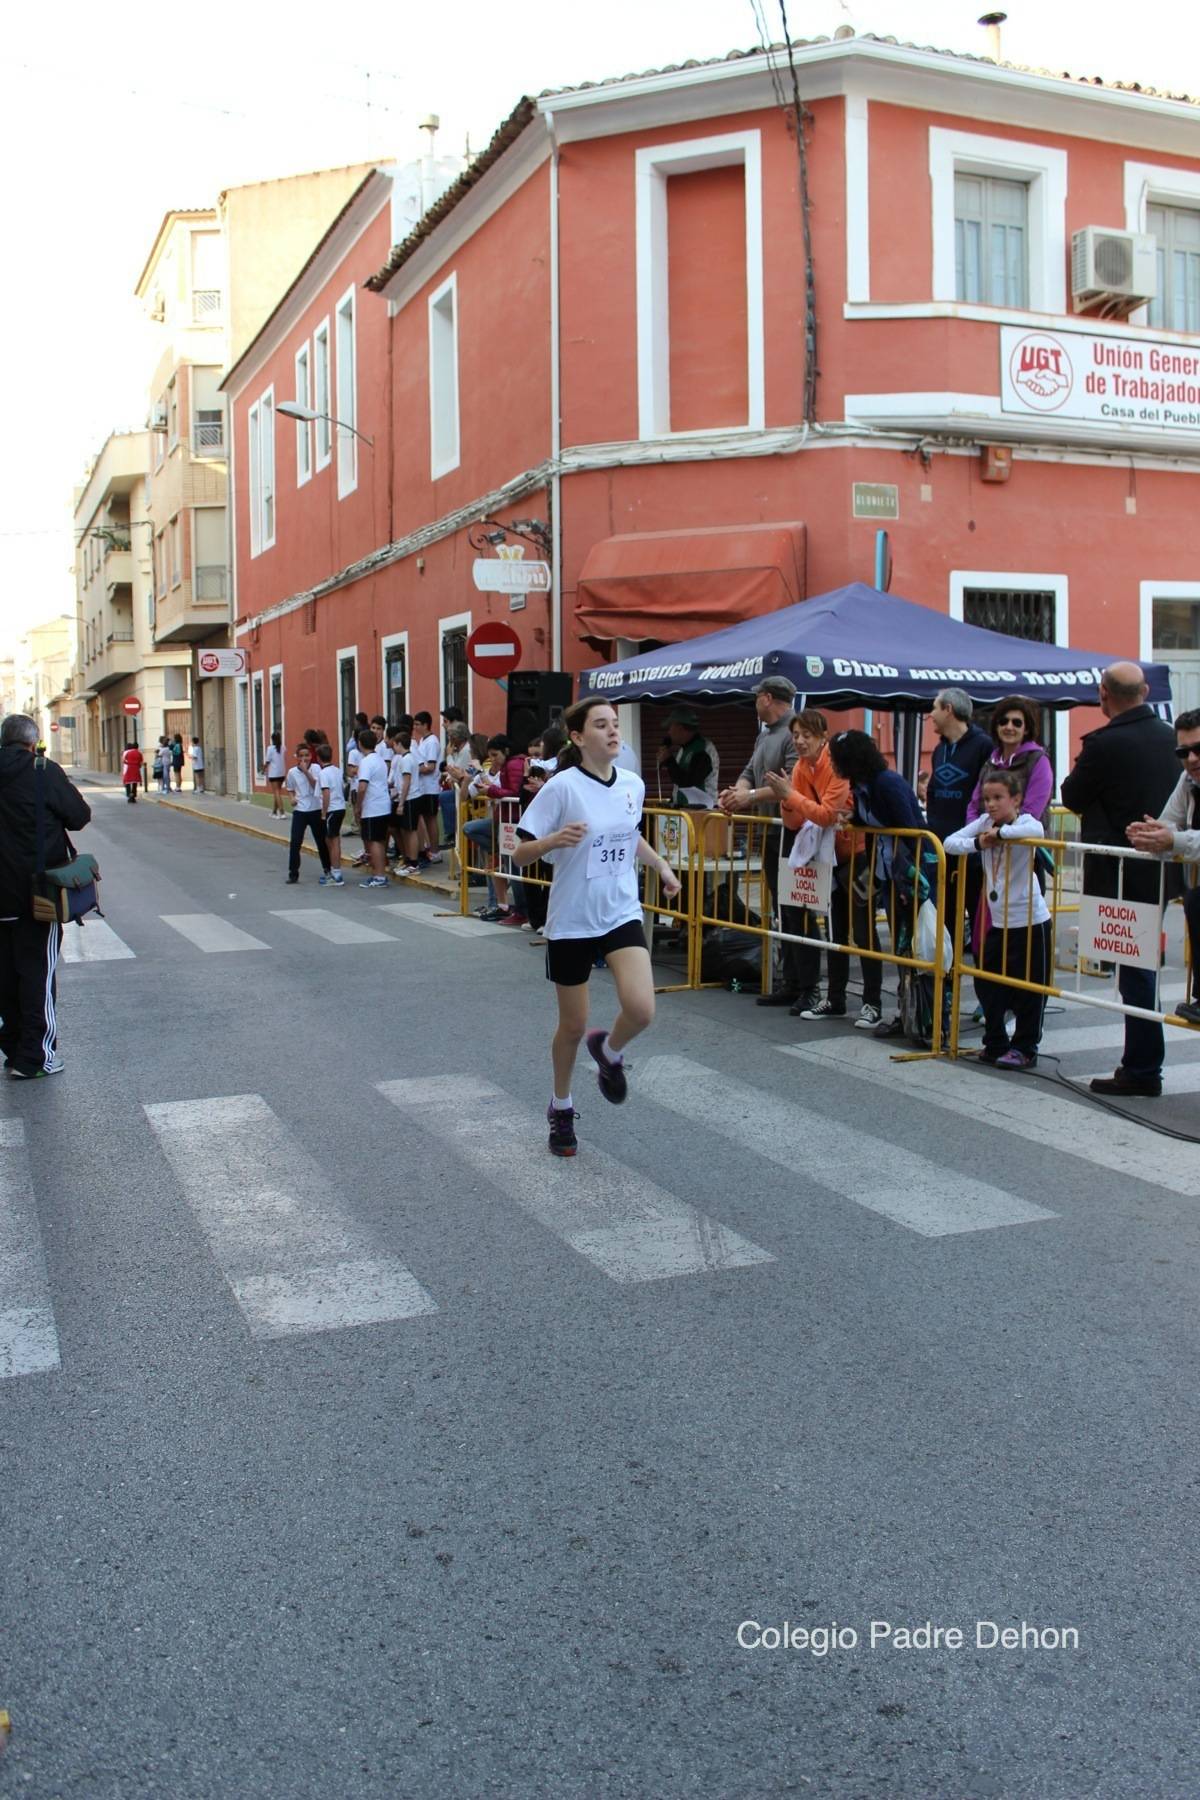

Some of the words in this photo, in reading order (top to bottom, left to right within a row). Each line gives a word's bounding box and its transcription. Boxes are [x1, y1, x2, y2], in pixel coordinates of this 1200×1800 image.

[1020, 346, 1062, 374] UGT
[1093, 343, 1143, 370] Unión
[1085, 371, 1106, 394] de
[1101, 403, 1135, 418] Casa
[1139, 408, 1160, 420] del
[596, 672, 624, 688] Club
[832, 658, 899, 678] Club
[1021, 667, 1102, 685] Novel
[600, 848, 626, 863] 315
[796, 880, 816, 892] LOCAL
[791, 891, 820, 905] NOVELDA
[1098, 904, 1137, 922] POLICIA
[1101, 922, 1133, 939] LOCAL
[1093, 937, 1140, 957] NOVELDA
